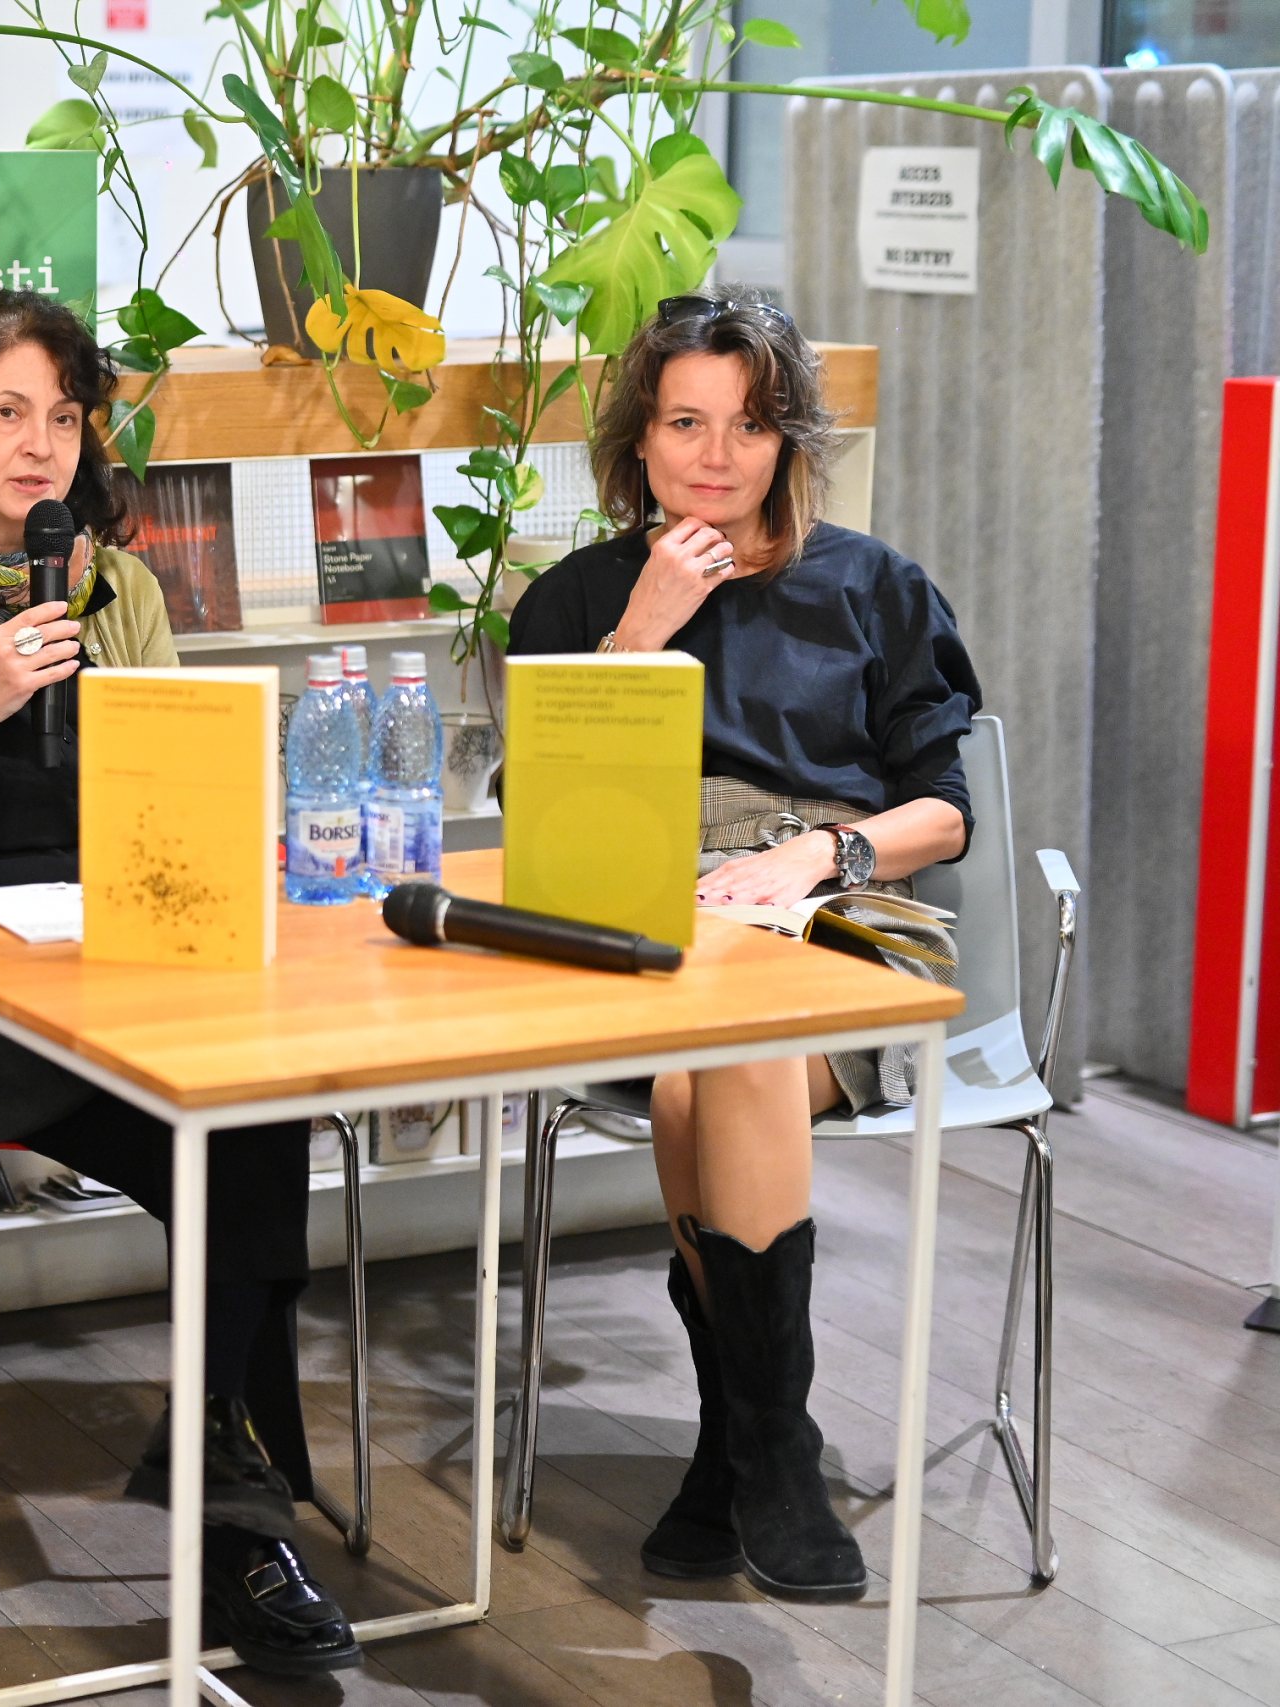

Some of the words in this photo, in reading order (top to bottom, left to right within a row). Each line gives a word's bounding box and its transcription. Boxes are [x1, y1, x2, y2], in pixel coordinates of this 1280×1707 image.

[903, 248, 953, 266] ENTRY
[324, 554, 348, 564] Stone
[350, 552, 373, 562] Paper
[324, 563, 364, 573] Notebook
